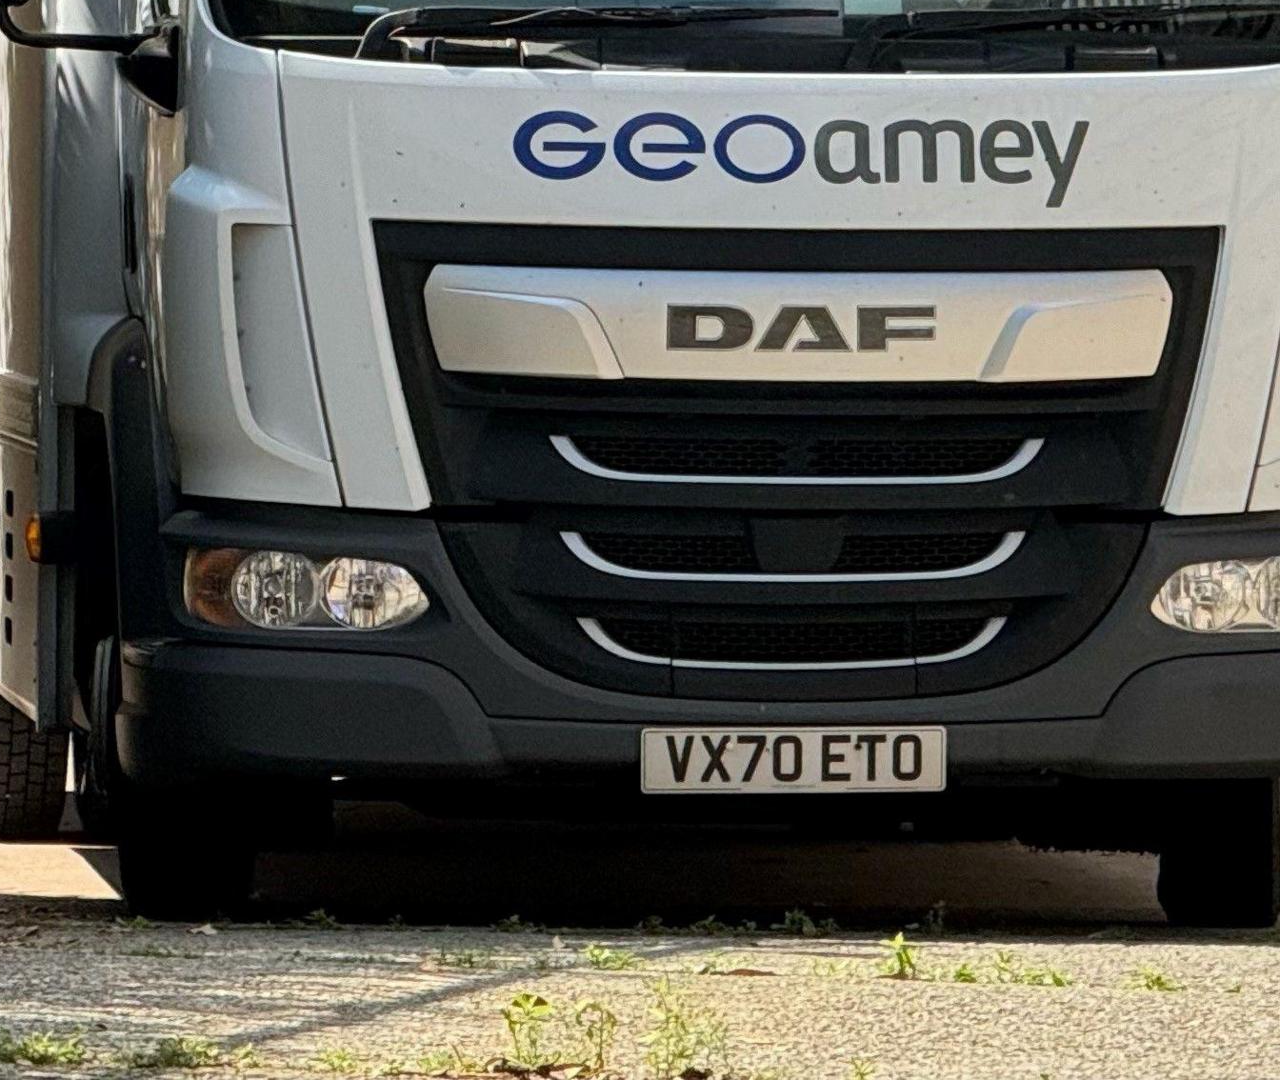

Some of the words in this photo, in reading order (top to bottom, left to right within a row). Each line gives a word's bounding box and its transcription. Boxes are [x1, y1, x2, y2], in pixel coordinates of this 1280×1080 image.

[666, 304, 937, 353] DAF
[665, 734, 803, 783] VX70
[821, 734, 923, 782] ETO
